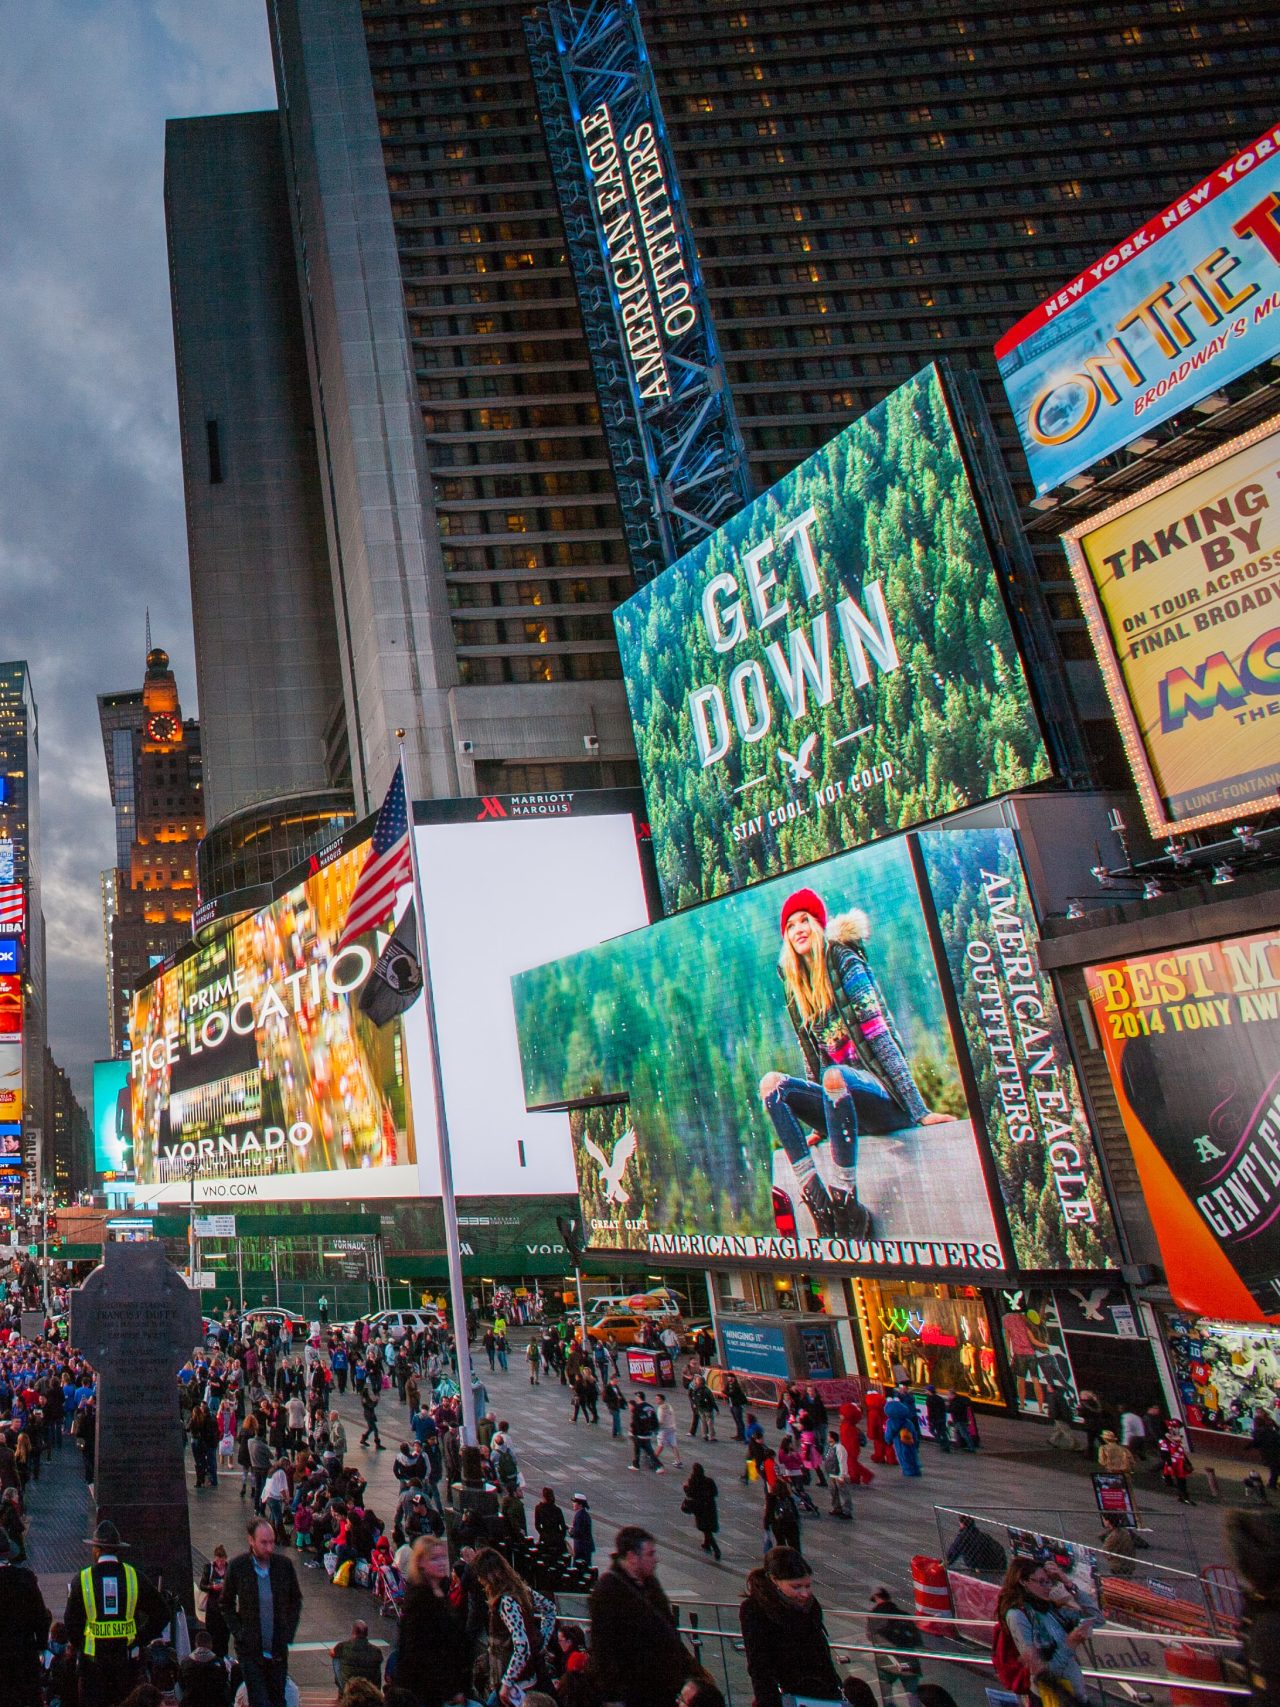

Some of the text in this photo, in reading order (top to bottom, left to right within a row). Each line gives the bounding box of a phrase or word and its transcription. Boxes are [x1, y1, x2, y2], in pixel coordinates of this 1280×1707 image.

[580, 103, 670, 400] AMERICAN EAGLE
[623, 122, 696, 337] OUTFITTERS
[1044, 281, 1084, 317] NEW
[1090, 230, 1157, 280] YORK,
[1161, 182, 1212, 229] NEW
[1028, 246, 1262, 447] ON THE
[1133, 318, 1248, 417] BROADWAY'S
[1102, 483, 1270, 580] TAKING
[1200, 516, 1263, 574] BY
[700, 506, 824, 655] GET
[1122, 611, 1148, 633] ON
[1149, 587, 1201, 620] TOUR
[1128, 622, 1191, 660] FINAL
[687, 579, 901, 770] DOWN
[511, 793, 574, 805] MARRIOTT
[512, 804, 569, 815] MARQUIS
[731, 761, 902, 842] STAY COOL. NOT COLD.
[189, 967, 246, 1016] PRIME
[1096, 951, 1216, 1013] BEST
[967, 939, 1036, 1145] OUTFITTERS
[1108, 998, 1233, 1040] 2014 TONY
[979, 868, 1097, 1224] AMERICAN EAGLE
[163, 1121, 314, 1164] VORNADO
[232, 1154, 287, 1168] TRUST
[1193, 1135, 1227, 1164] A
[202, 1184, 258, 1198] VNO.COM
[591, 1217, 620, 1230] GREAT
[650, 1233, 1004, 1270] AMERICAN EAGLE OUTFITTERS
[89, 1622, 112, 1637] PUBLIC
